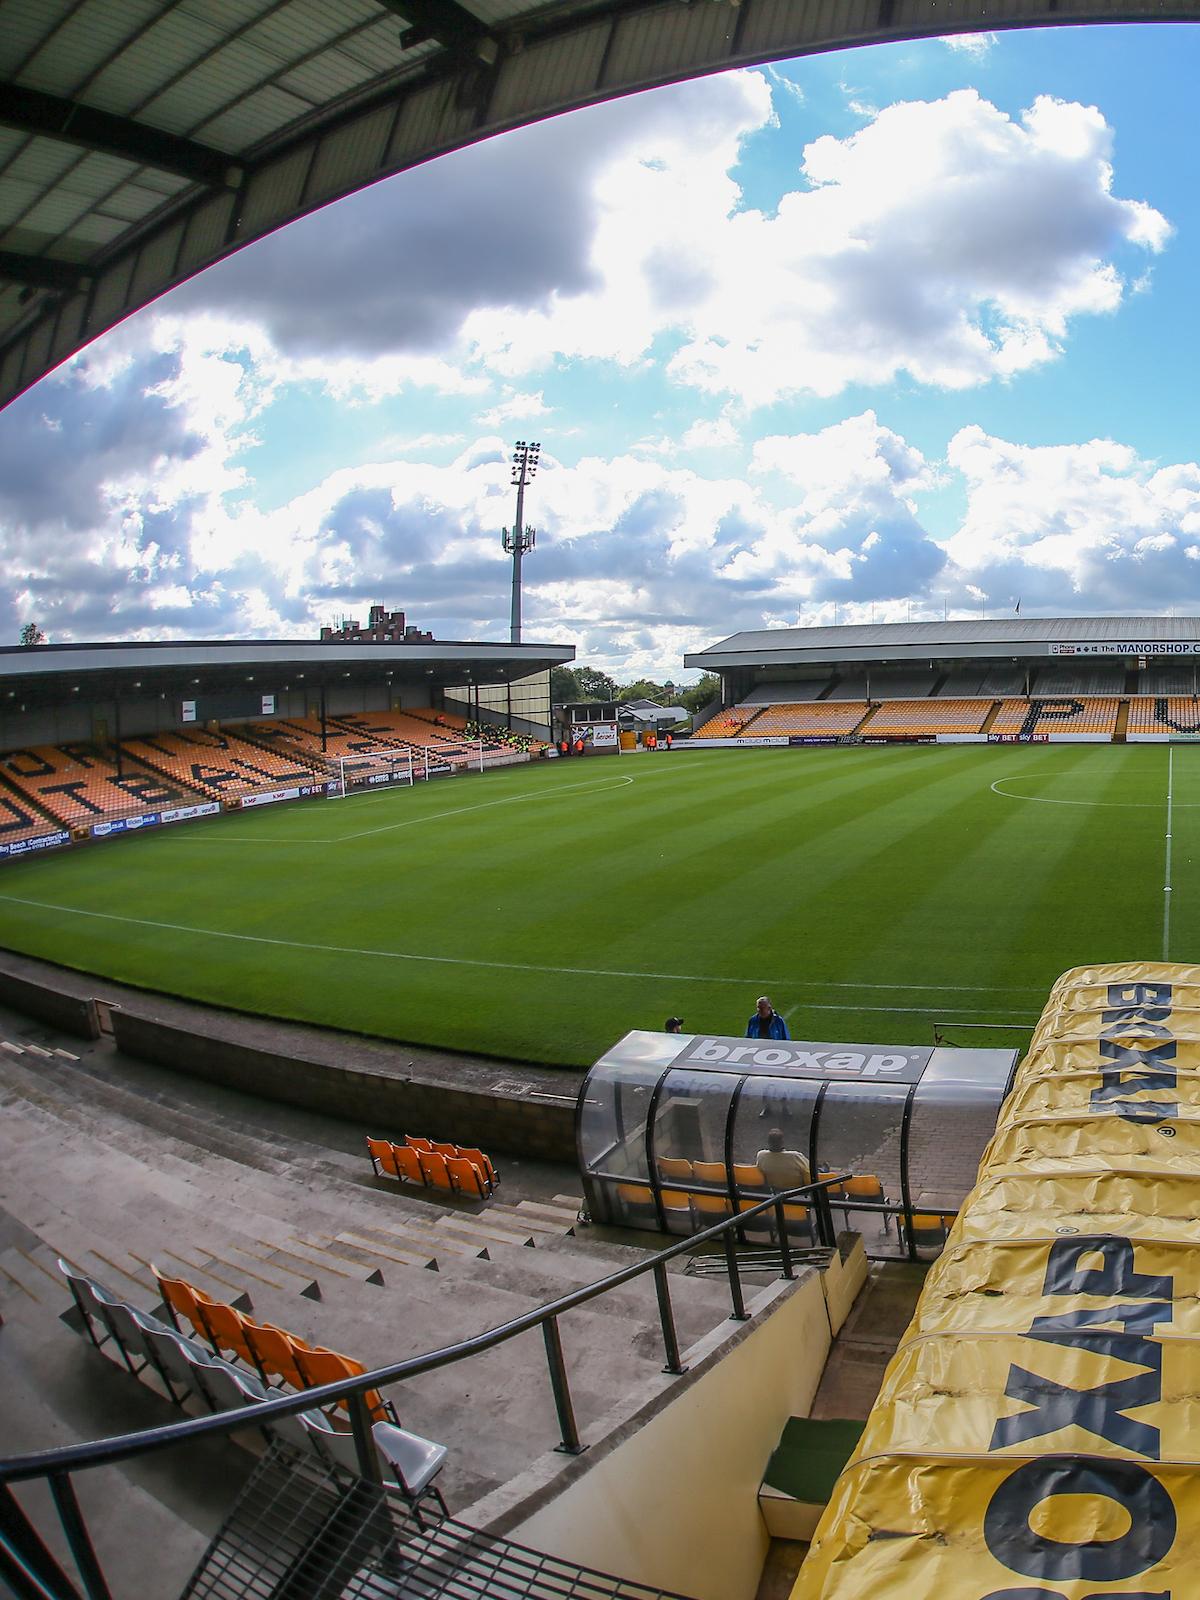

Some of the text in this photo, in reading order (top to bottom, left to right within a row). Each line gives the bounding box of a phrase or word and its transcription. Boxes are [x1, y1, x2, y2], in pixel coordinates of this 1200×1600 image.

[989, 734, 1000, 742] sky
[302, 786, 310, 795] sky
[328, 782, 337, 790] sky
[10, 841, 26, 850] Beech
[689, 1040, 908, 1076] broxap
[1089, 983, 1178, 1124] BROXAP
[979, 1234, 1178, 1600] OXAP
